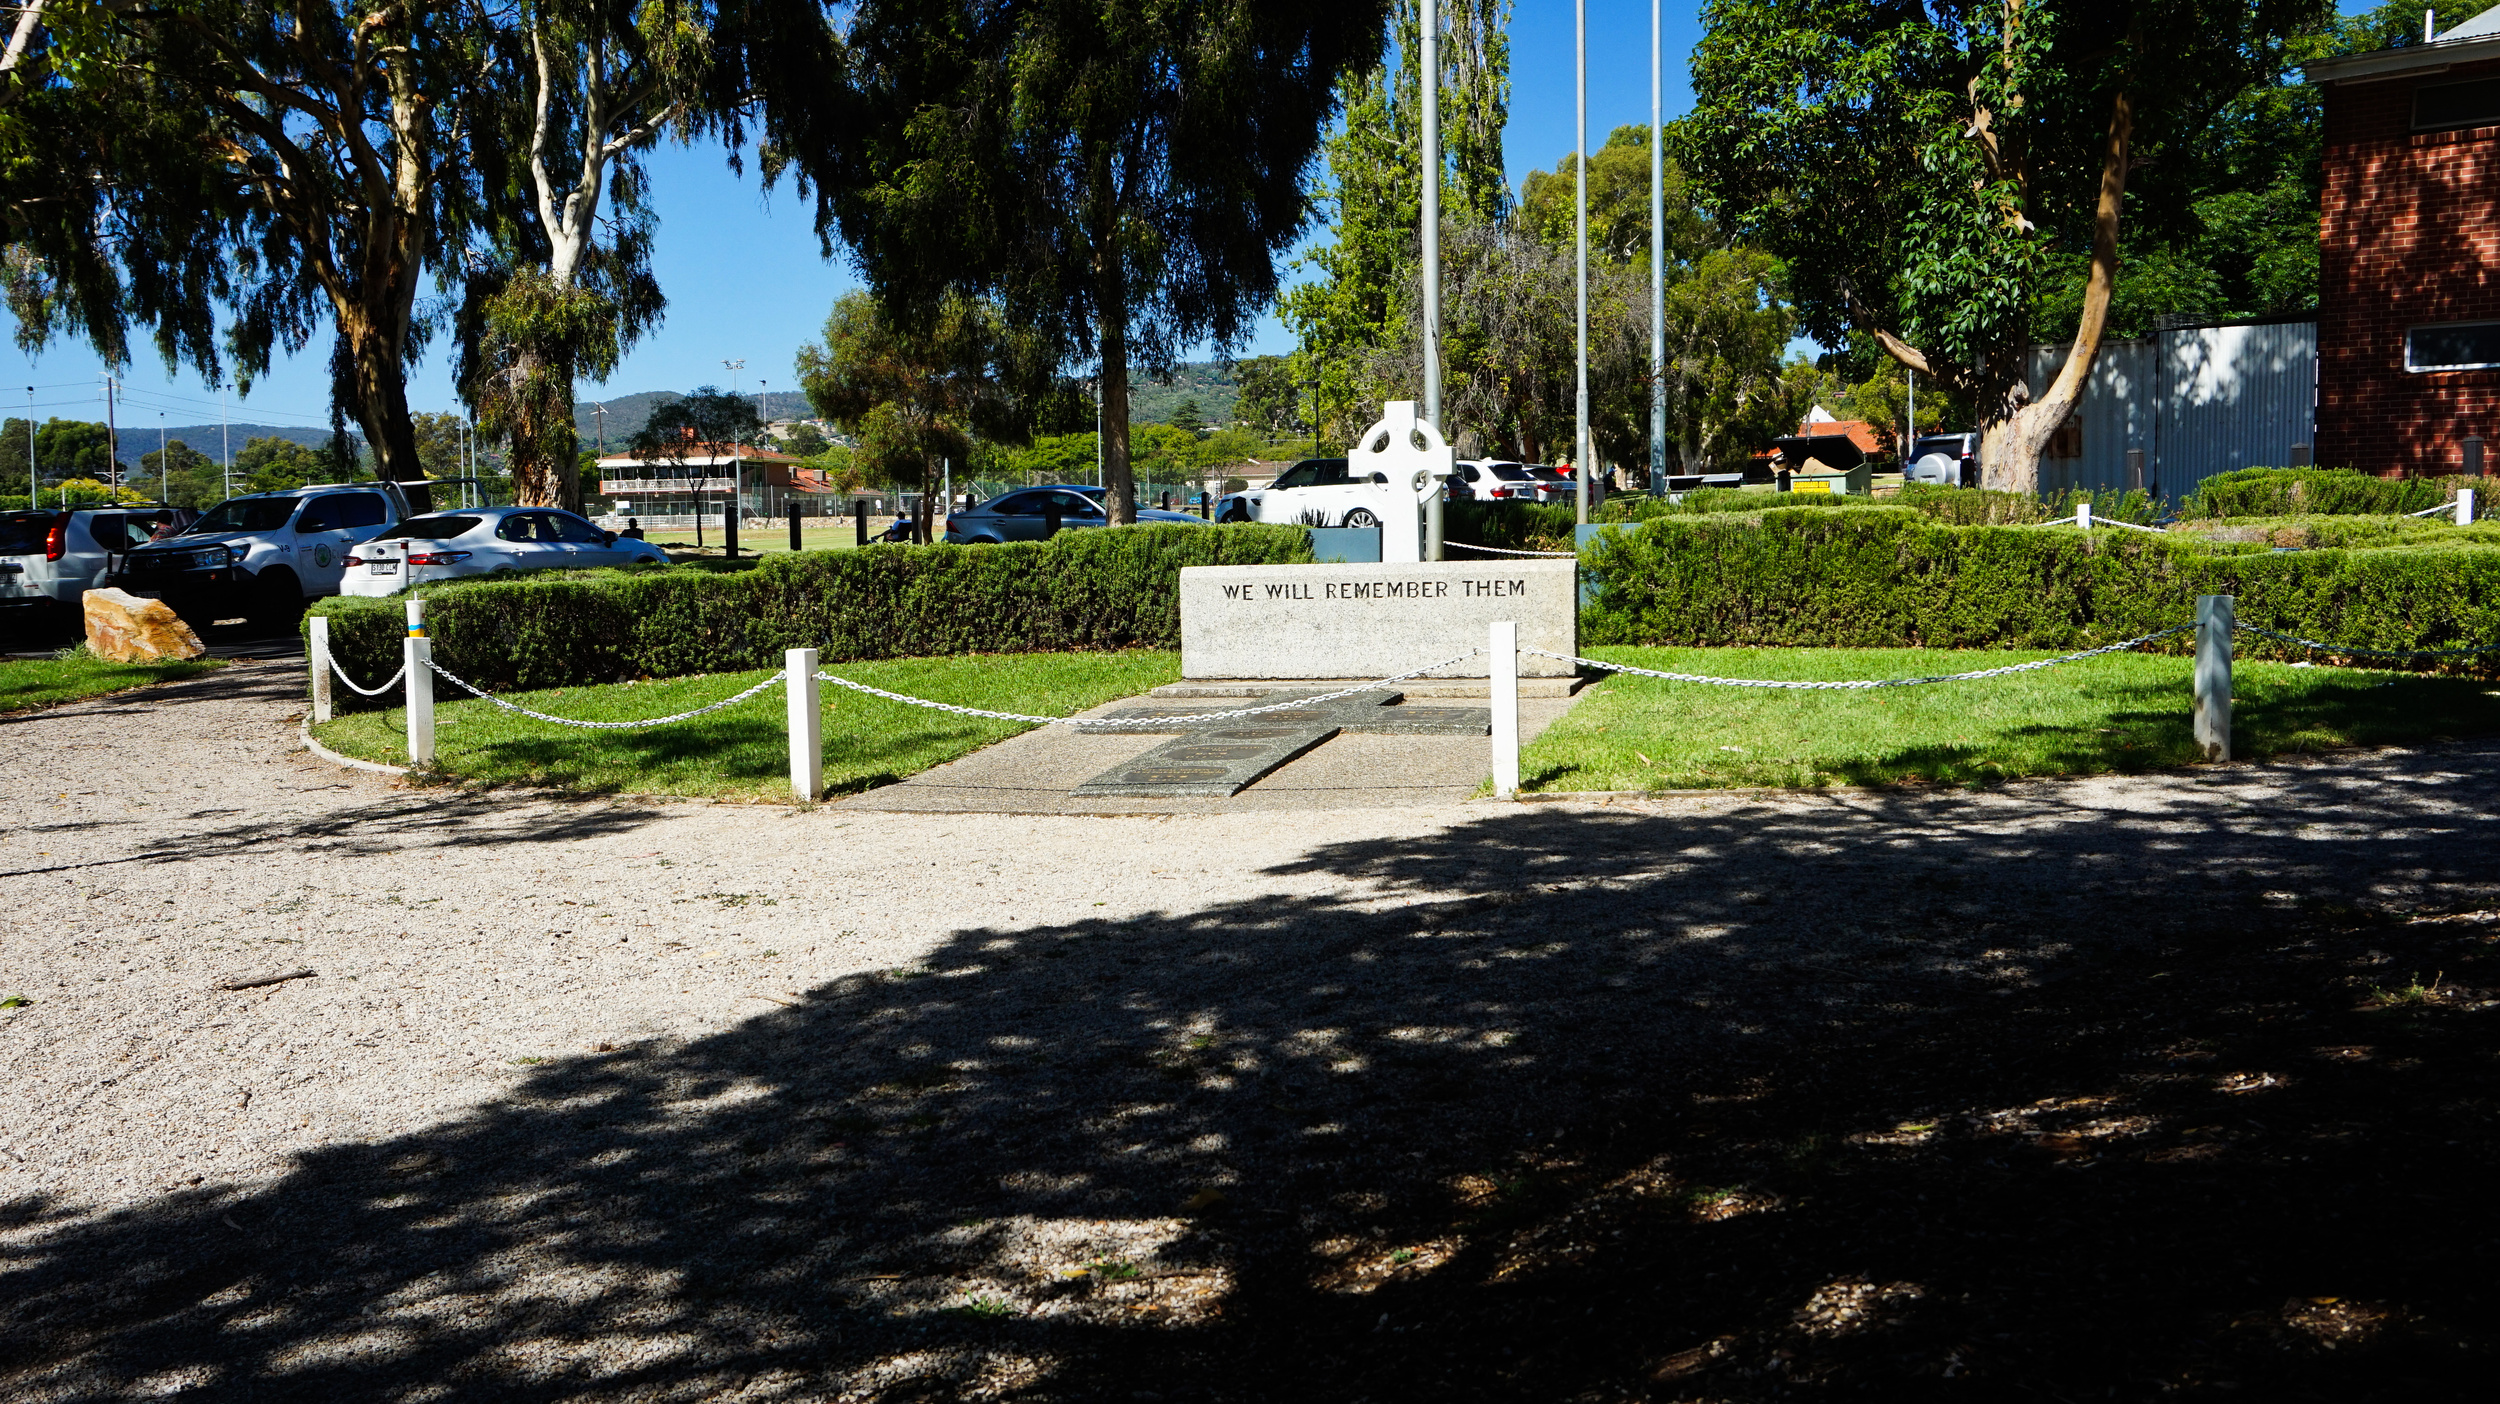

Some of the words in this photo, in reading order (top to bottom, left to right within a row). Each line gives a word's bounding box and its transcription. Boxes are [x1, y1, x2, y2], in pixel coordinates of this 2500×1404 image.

[1222, 584, 1253, 600] WE
[1265, 583, 1314, 600] WILL
[1326, 581, 1448, 599] REMEMBER
[1462, 580, 1525, 597] THEM
